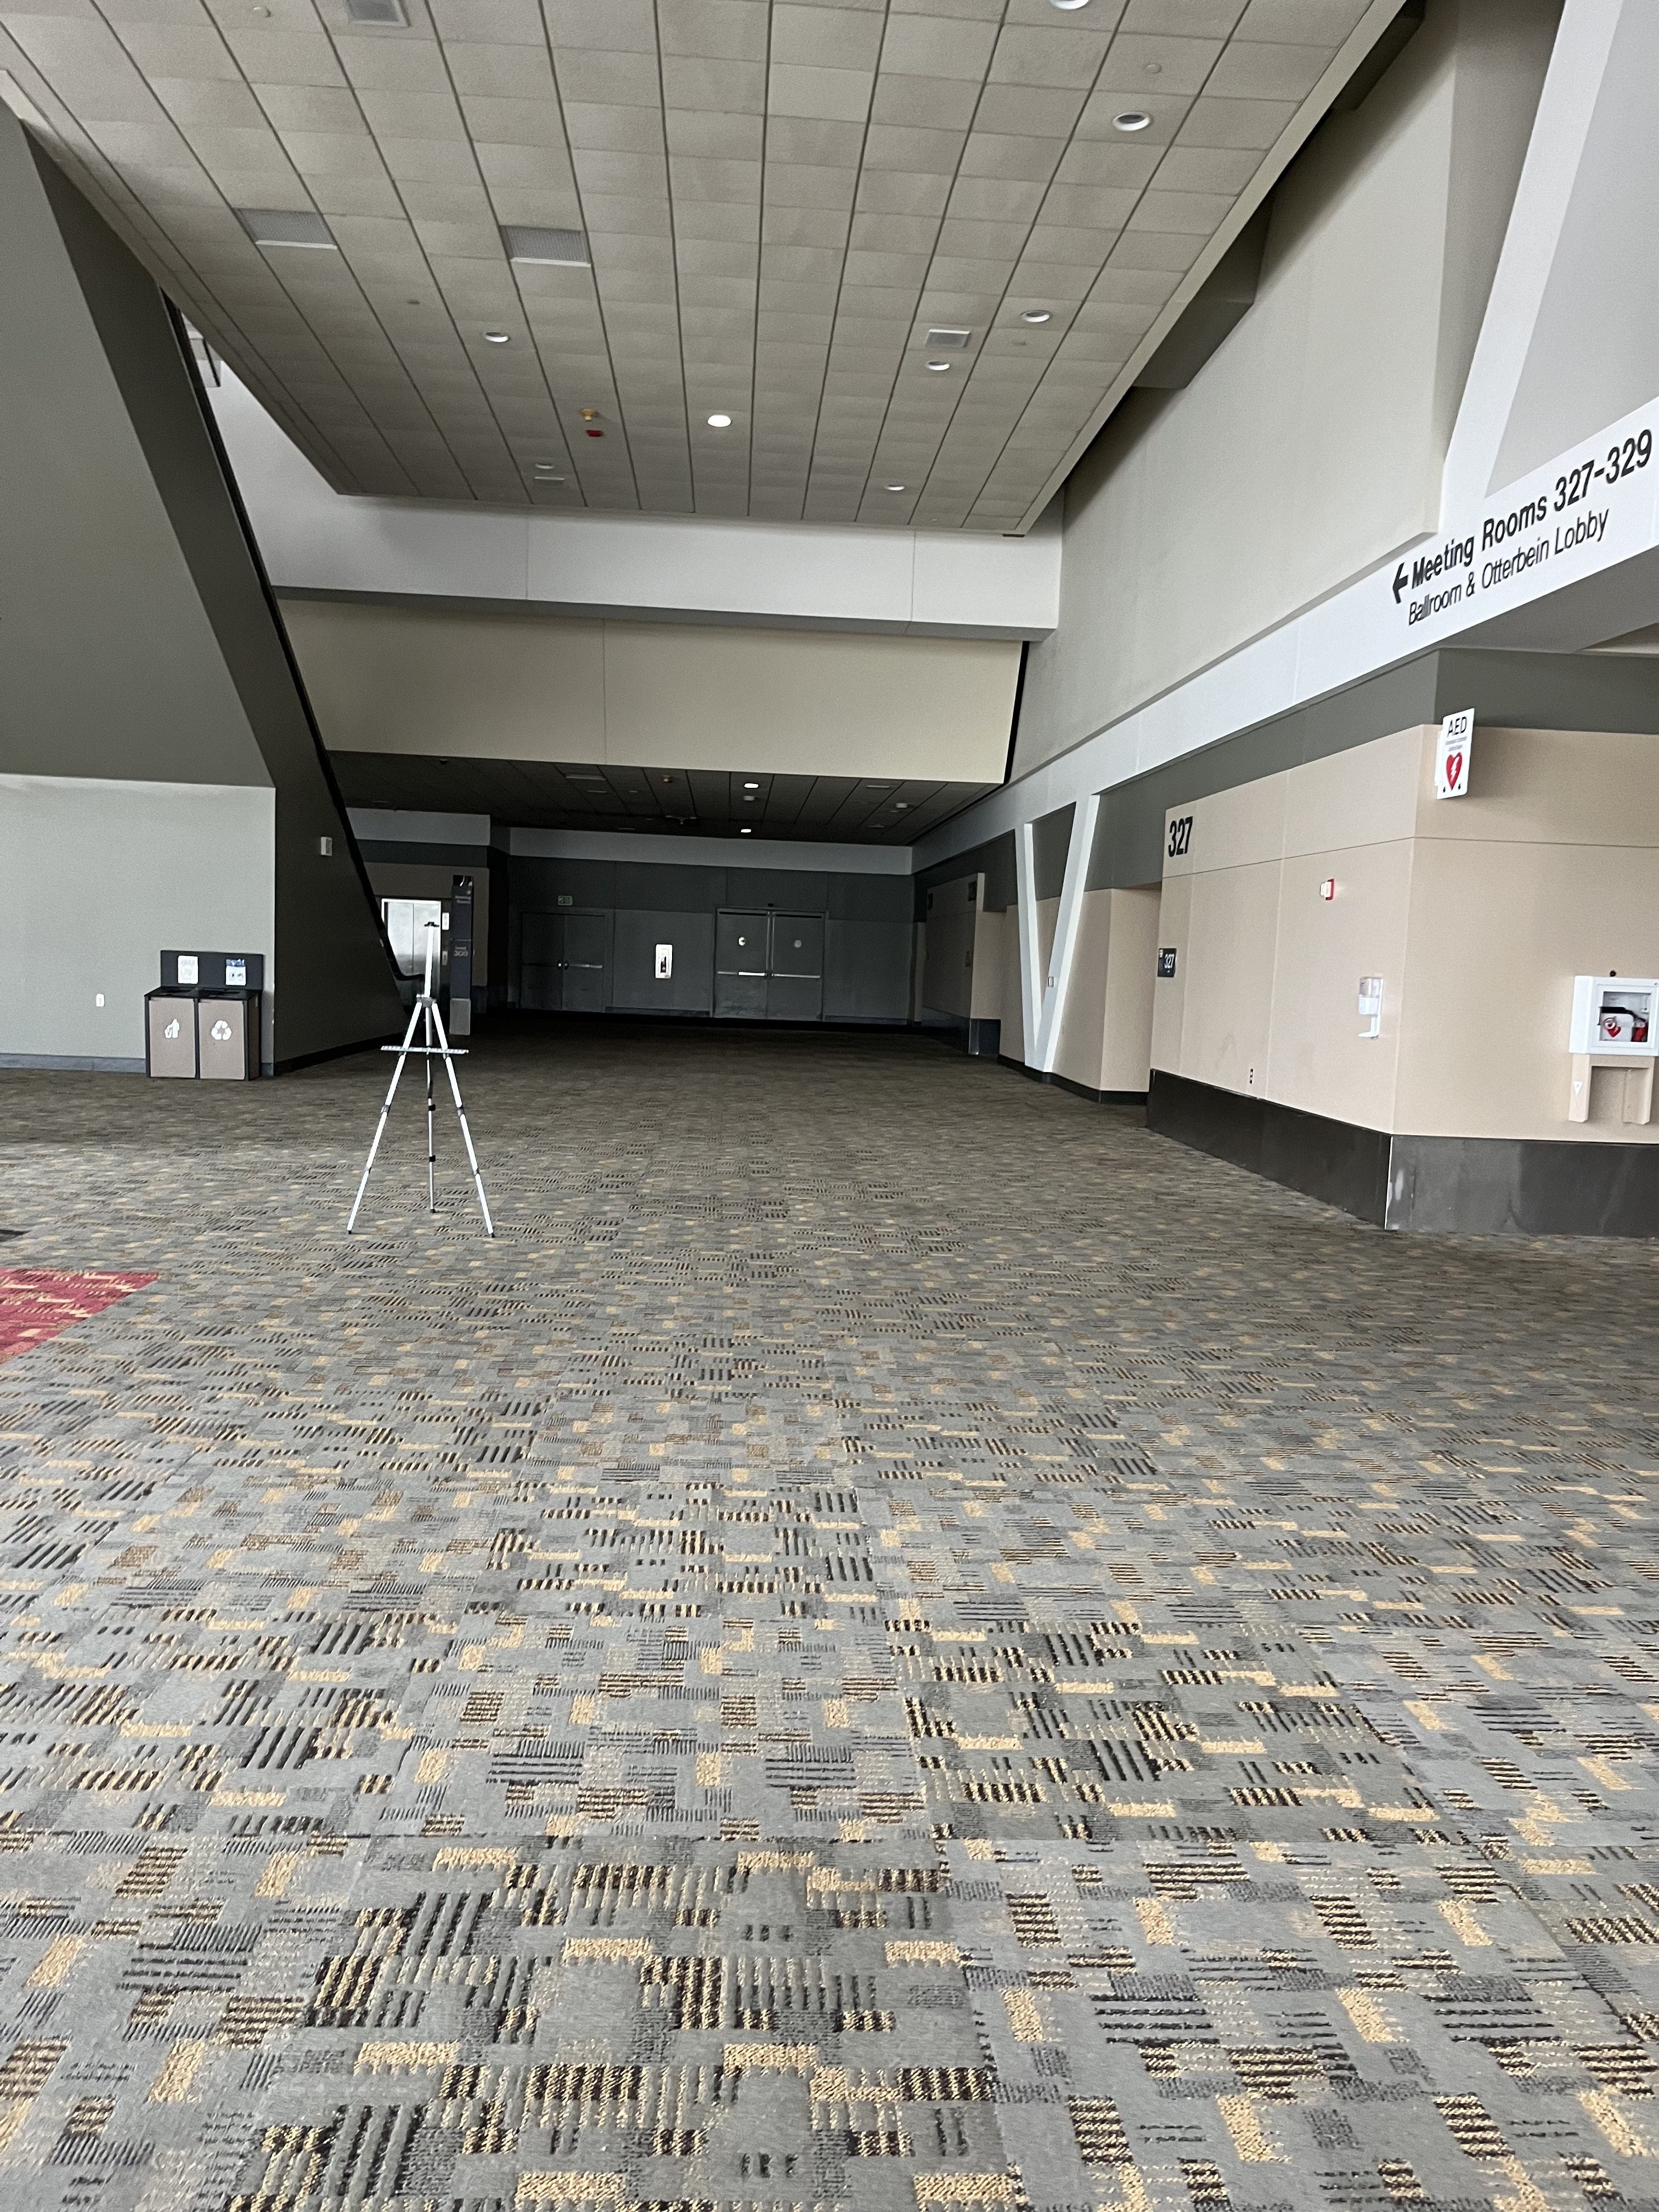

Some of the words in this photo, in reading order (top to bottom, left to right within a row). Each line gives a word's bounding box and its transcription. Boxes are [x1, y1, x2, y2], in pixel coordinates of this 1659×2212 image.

[1411, 535, 1475, 590] Meeting
[1481, 495, 1547, 552] Rooms
[1553, 429, 1652, 512] 327-329
[1408, 584, 1462, 626] Ballroom
[1465, 571, 1476, 597] &
[1482, 536, 1550, 589] Otterbein
[1554, 508, 1610, 555] Lobby
[1447, 716, 1468, 737] AED
[1168, 816, 1193, 857] 327
